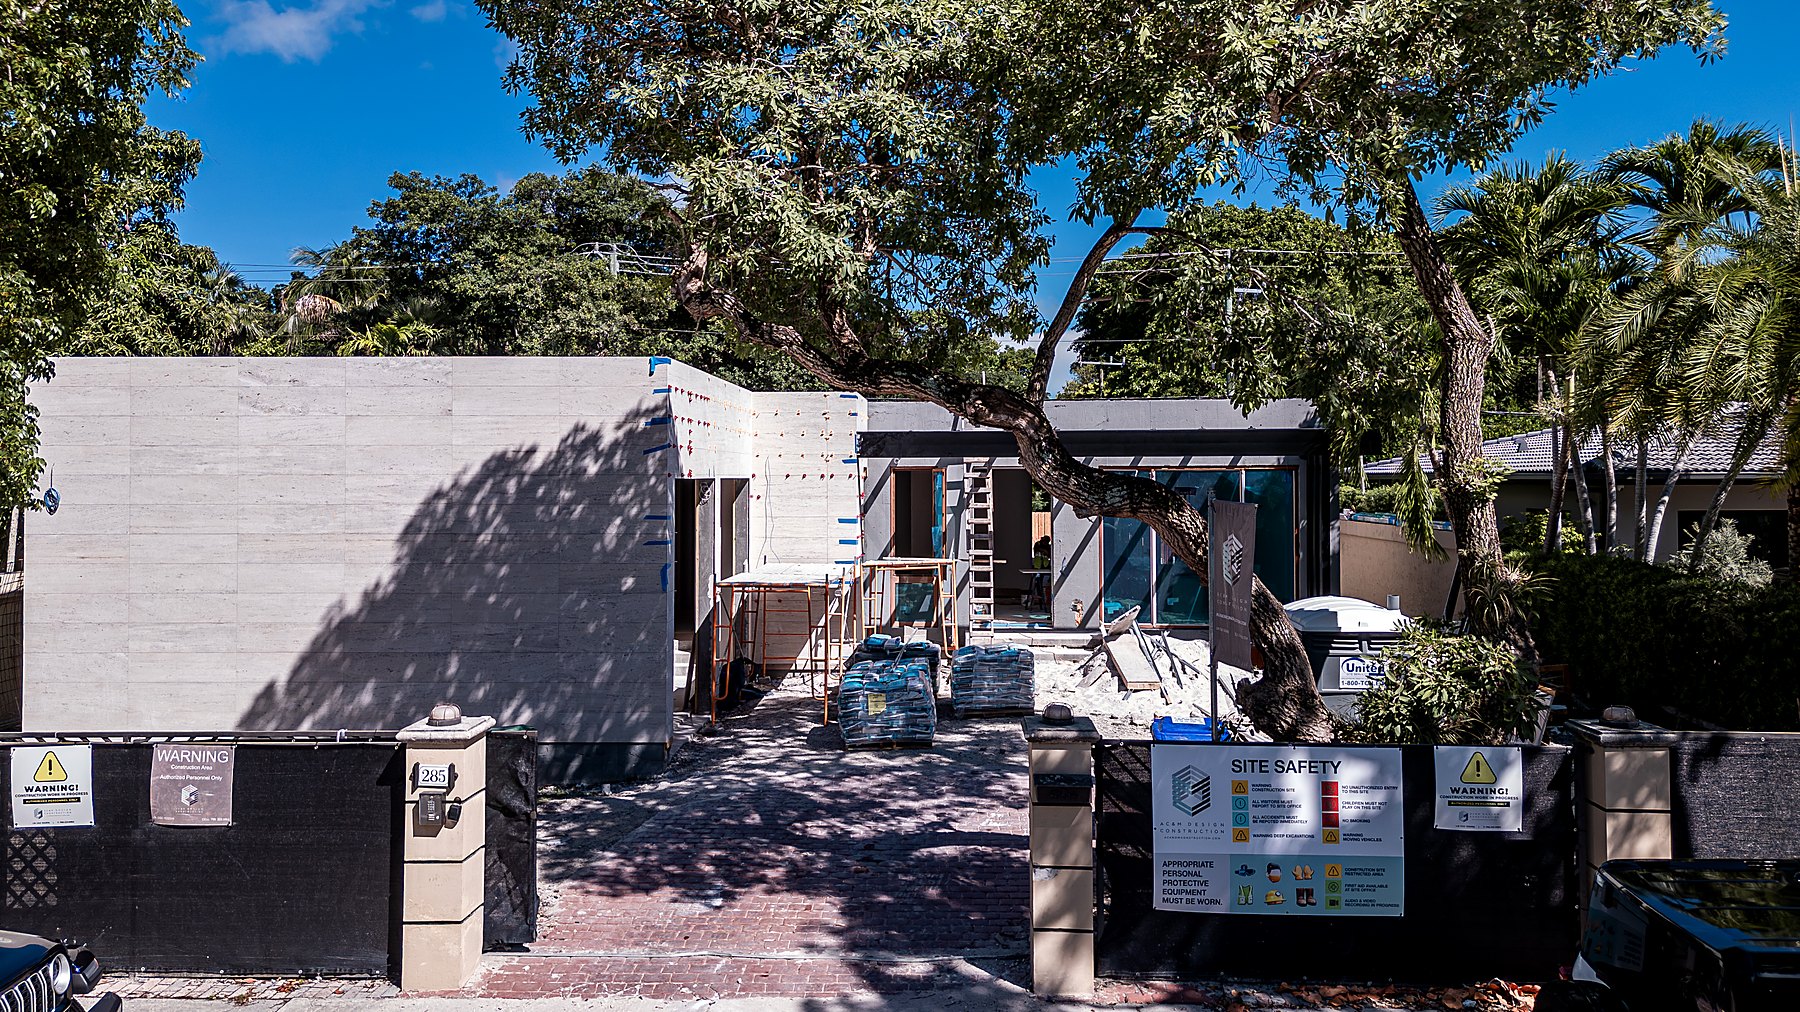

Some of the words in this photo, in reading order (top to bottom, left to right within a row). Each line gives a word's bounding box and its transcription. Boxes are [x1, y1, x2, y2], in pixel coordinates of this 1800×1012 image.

[158, 749, 229, 763] WARNING
[1231, 759, 1269, 774] SITE
[1274, 760, 1341, 774] SAFETY
[422, 769, 446, 782] 285
[24, 784, 78, 792] WARNING!
[1450, 787, 1508, 795] WARNING!
